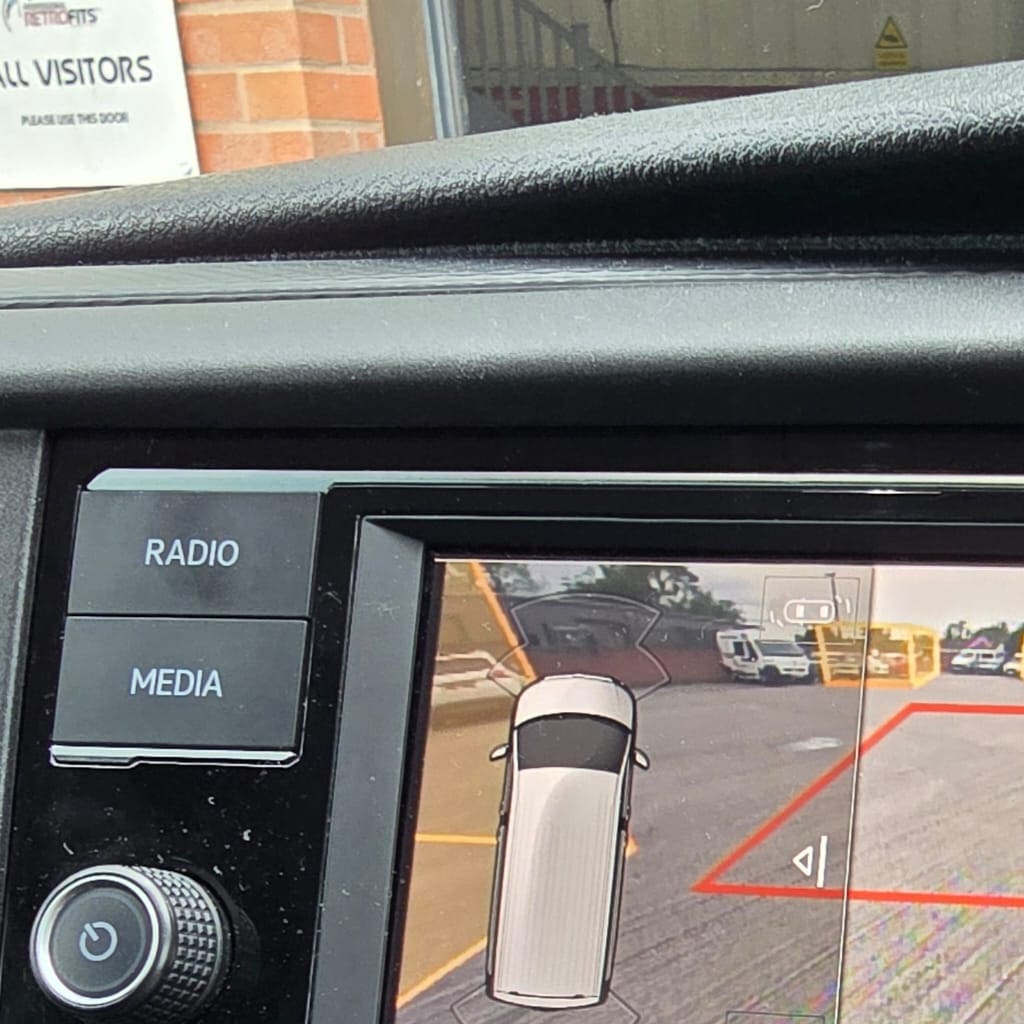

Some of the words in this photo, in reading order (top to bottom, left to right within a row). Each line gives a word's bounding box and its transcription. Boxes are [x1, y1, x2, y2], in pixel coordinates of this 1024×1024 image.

[0, 61, 29, 88] LL
[34, 55, 153, 86] VISITORS
[21, 114, 56, 126] PLEASE
[57, 113, 75, 125] USE
[76, 112, 98, 124] THIS
[99, 111, 129, 124] DOOR
[144, 538, 240, 567] RADIO
[130, 668, 223, 698] MEDIA
